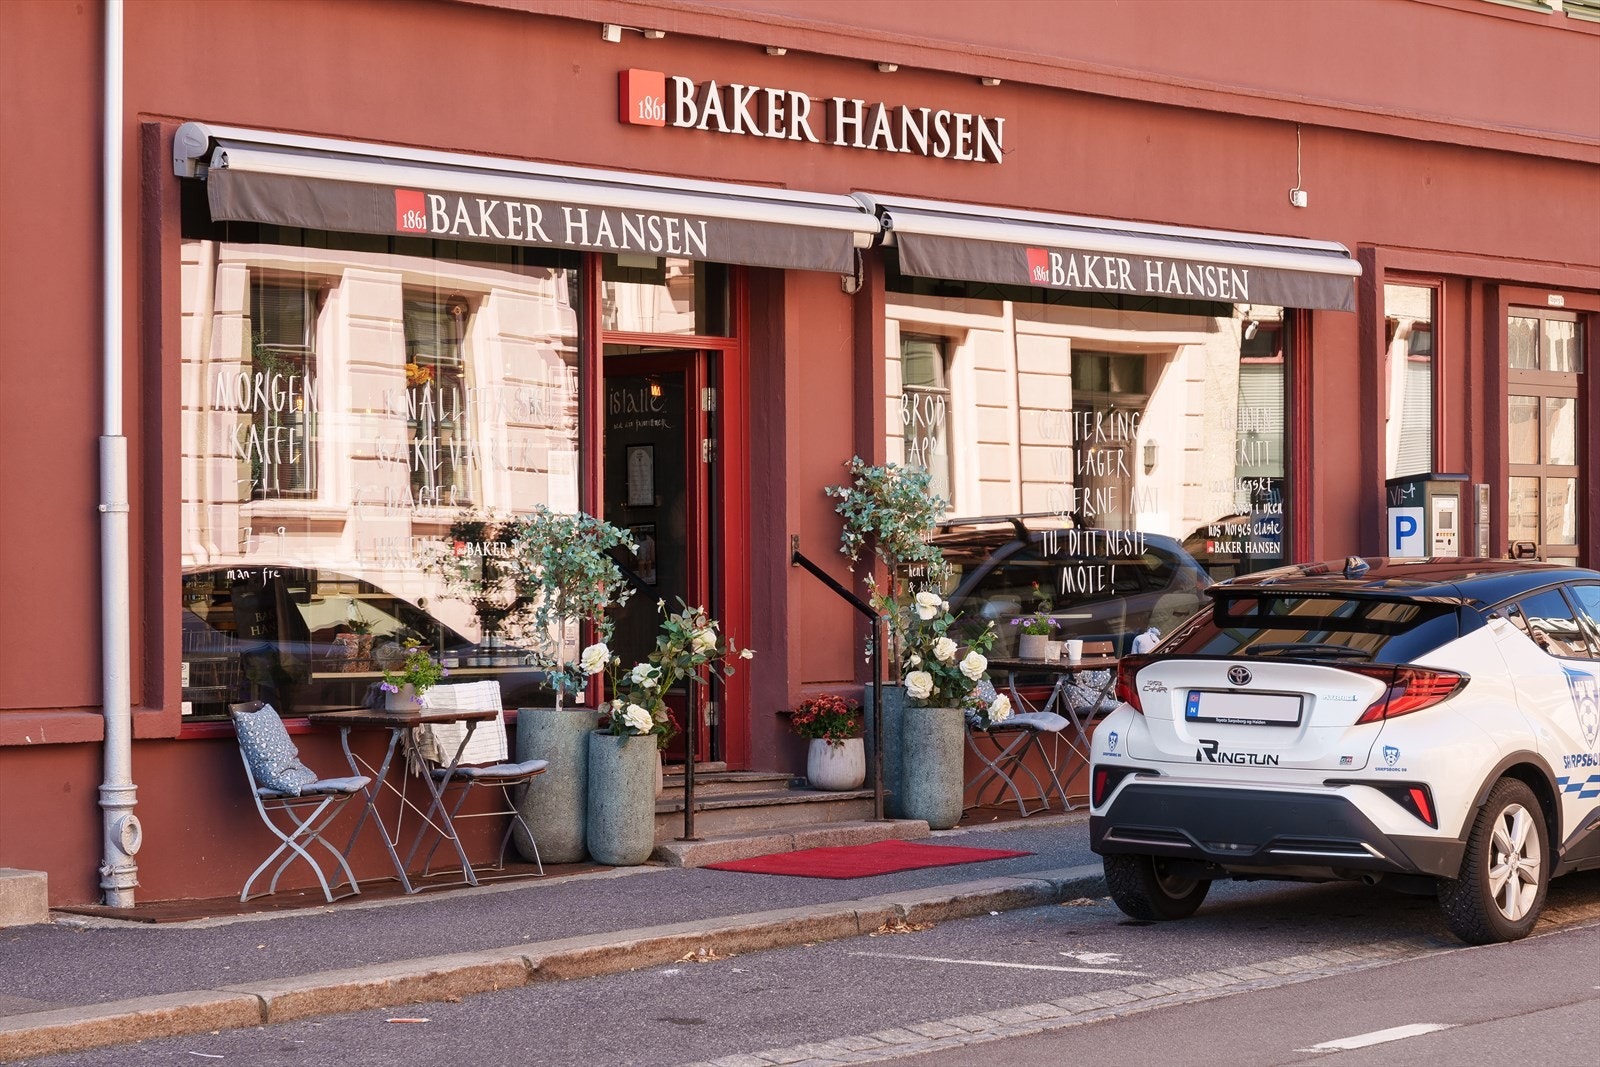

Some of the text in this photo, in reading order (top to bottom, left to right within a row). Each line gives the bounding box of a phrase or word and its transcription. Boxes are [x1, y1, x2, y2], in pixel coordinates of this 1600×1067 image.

[638, 75, 1006, 164] 1861 BAKER HANSEN
[402, 193, 708, 258] 1861 BAKER HANSEN
[1049, 252, 1137, 291] BAKER
[1144, 259, 1249, 301] HANSEN
[216, 370, 319, 414] MORGEN
[231, 422, 303, 465] KAFFE
[1077, 449, 1131, 479] LAGER
[467, 541, 510, 558] BAKER
[1041, 524, 1150, 558] TIL DITT NESTE
[1214, 541, 1243, 554] BAKER
[1245, 541, 1281, 554] HANSEN
[1395, 516, 1418, 550] P
[1196, 738, 1280, 766] RINGTUN
